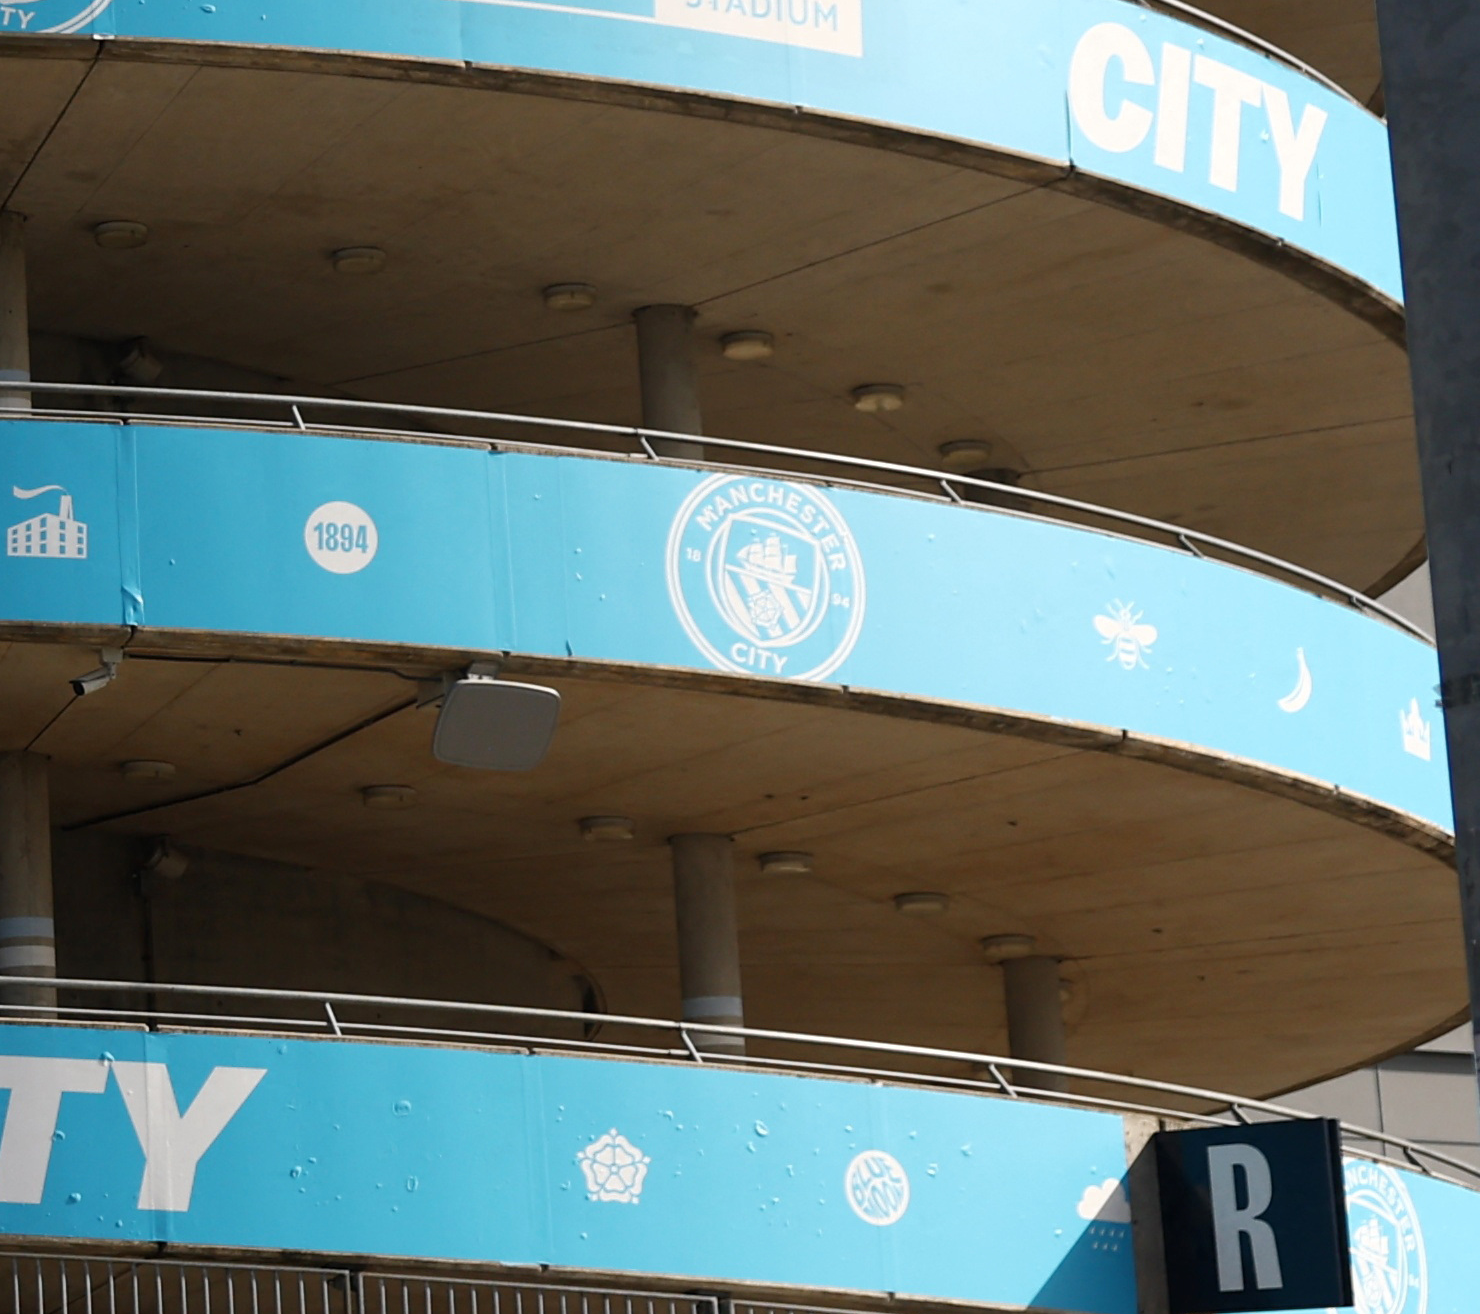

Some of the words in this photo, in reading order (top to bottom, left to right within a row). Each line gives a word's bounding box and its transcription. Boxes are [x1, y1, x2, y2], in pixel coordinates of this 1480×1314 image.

[1068, 21, 1328, 222] CITY
[313, 522, 369, 554] 1894
[685, 547, 701, 562] 18
[695, 482, 847, 571] MANCHESTER
[730, 642, 788, 674] CITY
[1207, 1142, 1283, 1292] R
[1344, 1166, 1416, 1251] NCHESTER
